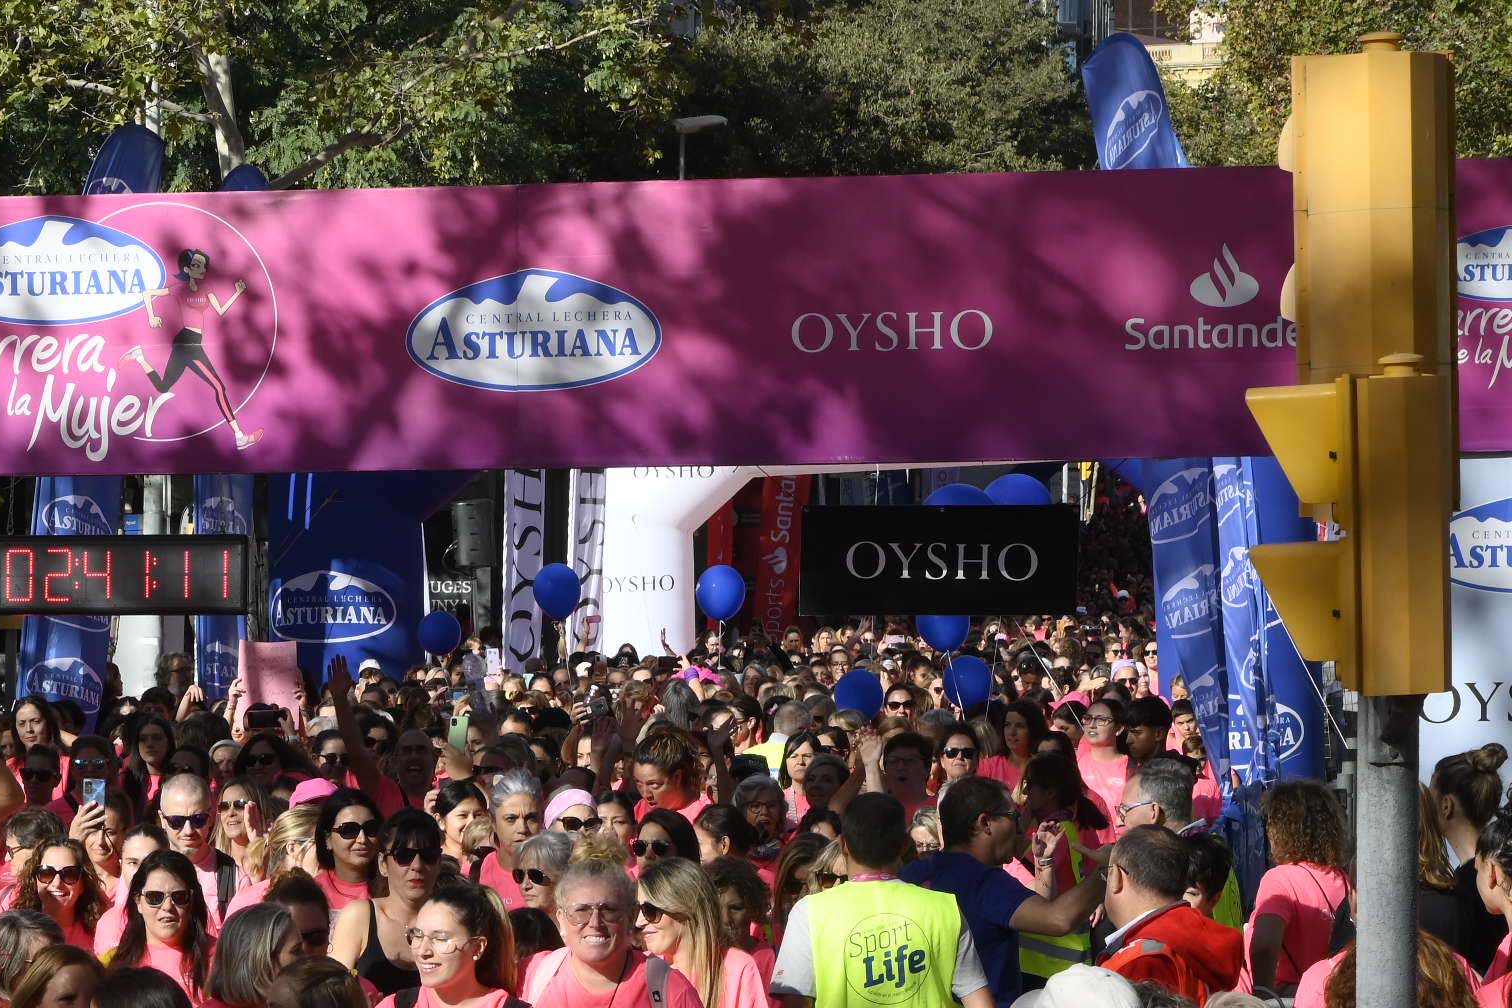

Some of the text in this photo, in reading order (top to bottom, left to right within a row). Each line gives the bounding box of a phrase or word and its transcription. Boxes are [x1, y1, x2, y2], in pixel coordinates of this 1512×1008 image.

[68, 253, 141, 264] LECHERA
[465, 309, 634, 324] CENTRAL LECHERA
[790, 308, 995, 354] OYSHO
[426, 313, 642, 361] ASTURIANA
[1475, 336, 1493, 365] la
[6, 375, 33, 417] la
[26, 367, 176, 462] Mujer
[633, 466, 715, 480] OYSHO
[845, 540, 1039, 582] OYSHO
[603, 573, 675, 595] OYSHO
[275, 604, 388, 628] ASTURIANA
[849, 919, 913, 958] Sport
[863, 944, 926, 990] Life
